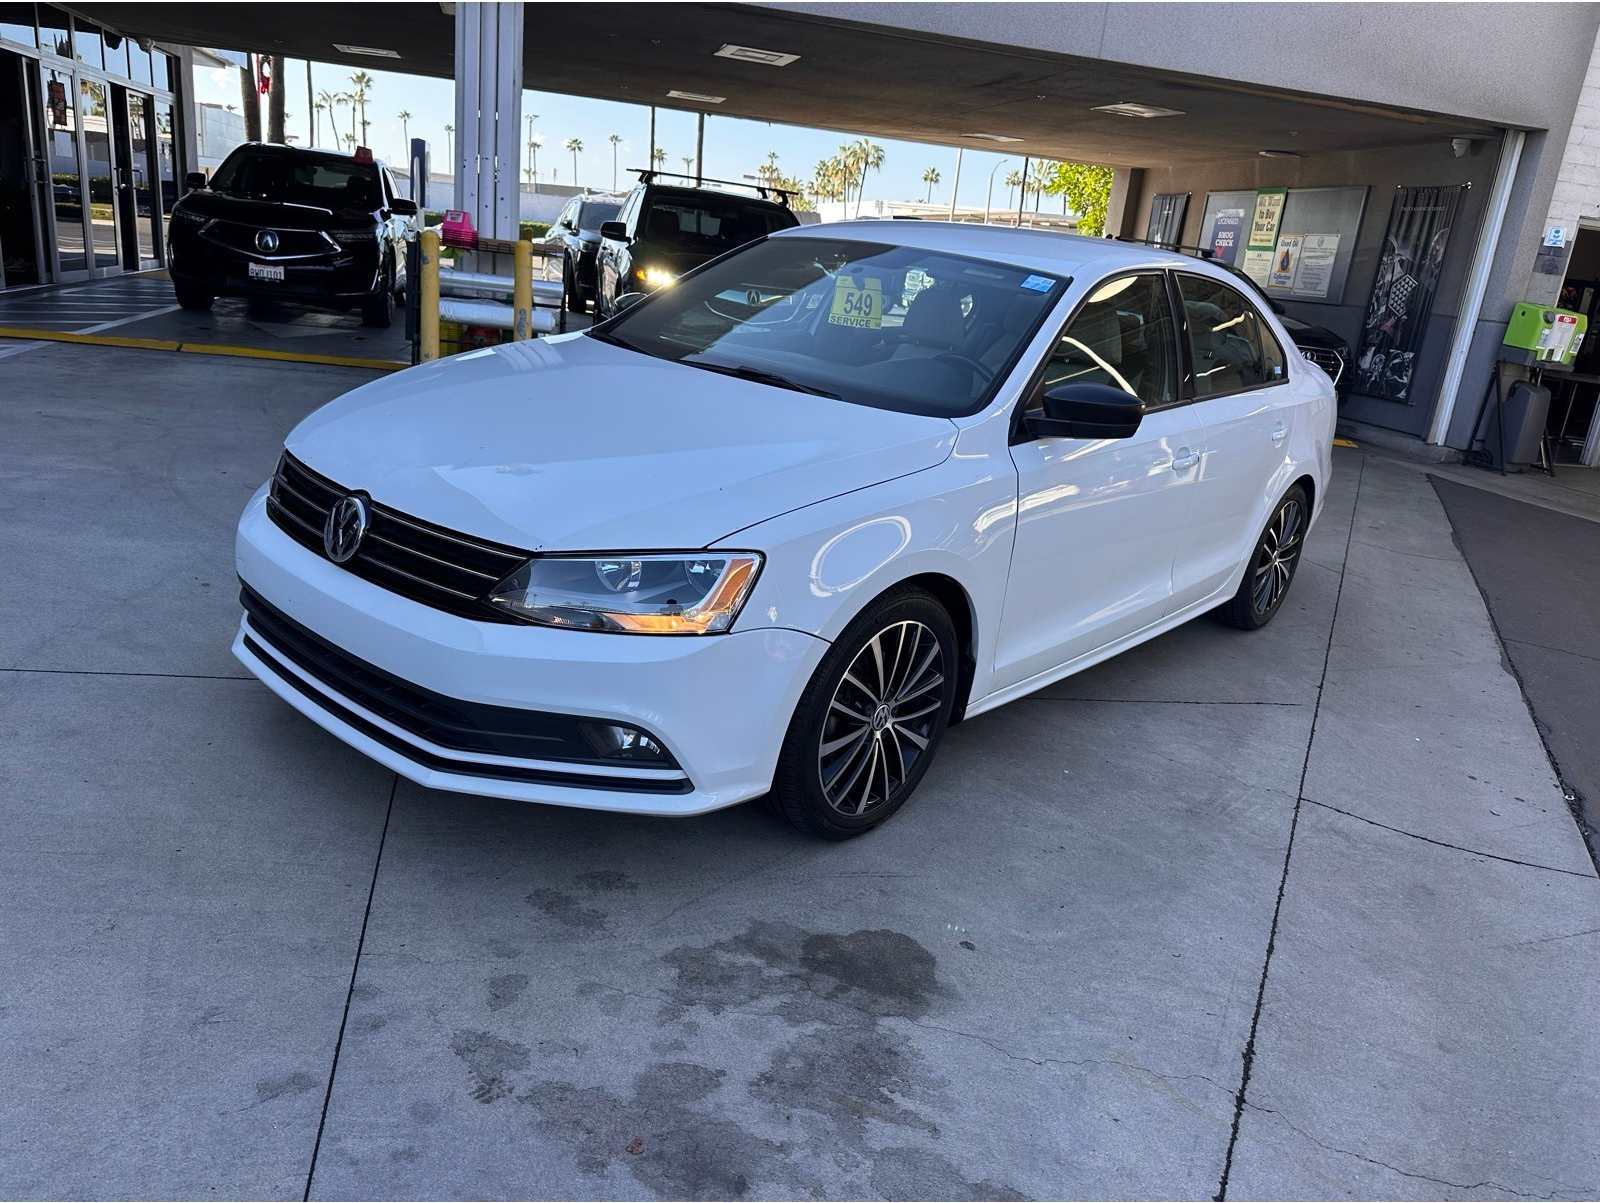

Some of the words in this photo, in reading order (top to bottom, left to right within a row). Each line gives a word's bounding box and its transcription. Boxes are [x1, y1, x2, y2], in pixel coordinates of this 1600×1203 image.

[1258, 209, 1265, 219] to
[1265, 208, 1276, 222] Buy
[1266, 220, 1276, 231] Car
[843, 292, 873, 316] 549
[830, 315, 872, 328] SERVICE
